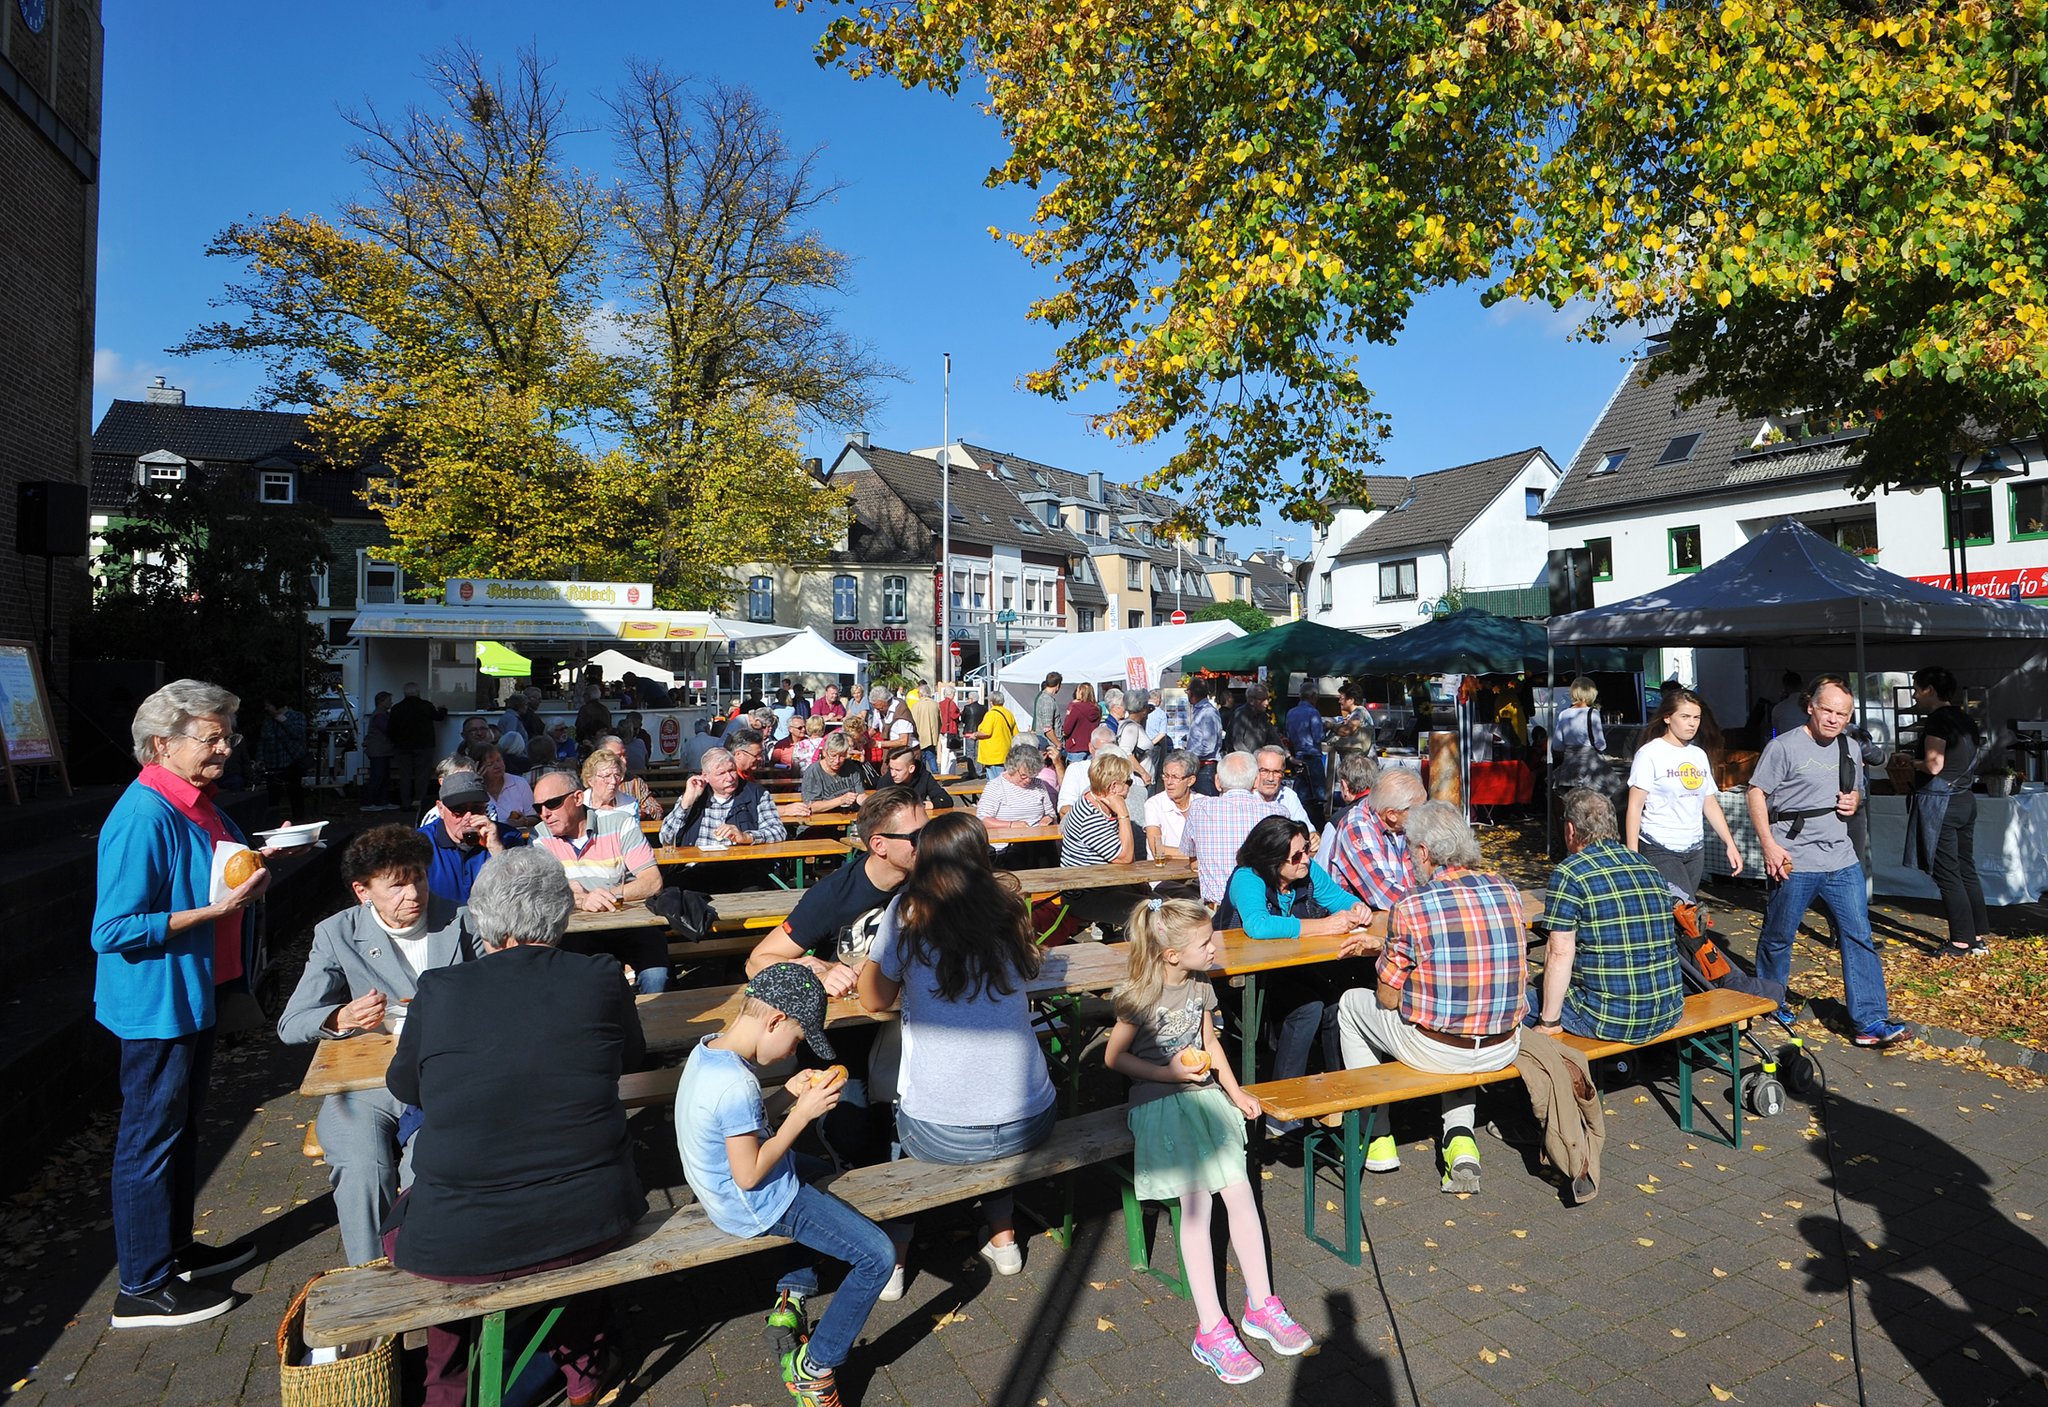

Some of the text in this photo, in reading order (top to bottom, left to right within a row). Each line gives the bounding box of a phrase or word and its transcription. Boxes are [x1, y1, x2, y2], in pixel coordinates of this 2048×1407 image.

[487, 583, 561, 600] Reissdorf
[566, 584, 616, 604] Kölsch
[836, 626, 906, 640] HÖRGERÄTE
[1667, 768, 1707, 779] Hard Rock
